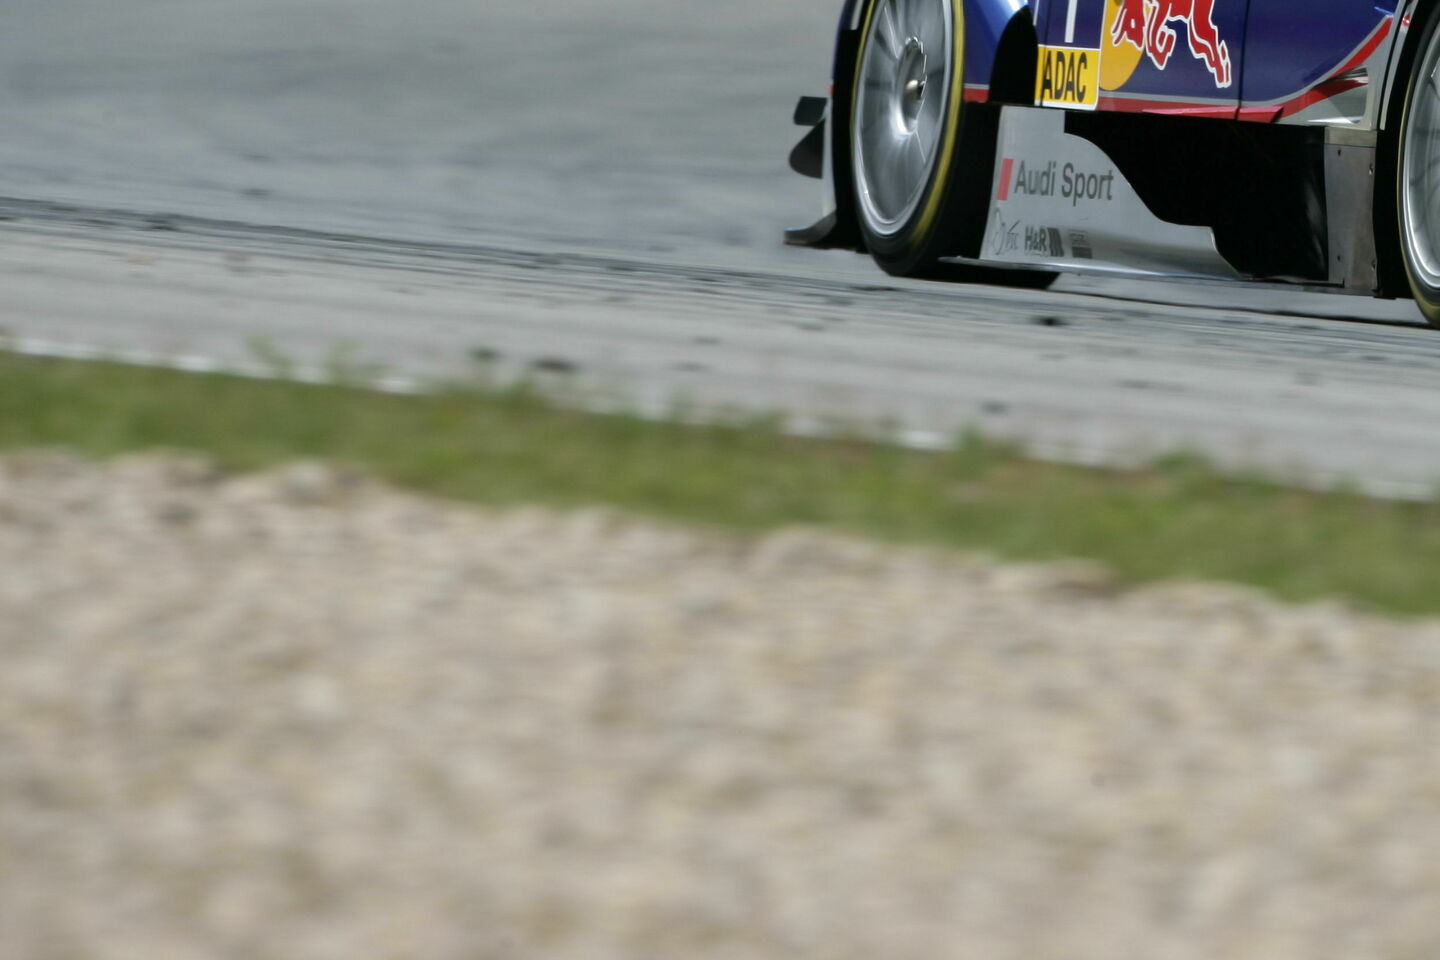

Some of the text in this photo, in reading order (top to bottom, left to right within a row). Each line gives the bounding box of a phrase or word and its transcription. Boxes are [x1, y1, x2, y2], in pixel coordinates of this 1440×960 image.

[1042, 50, 1087, 103] ADAC
[1013, 160, 1114, 207] Audi Sport
